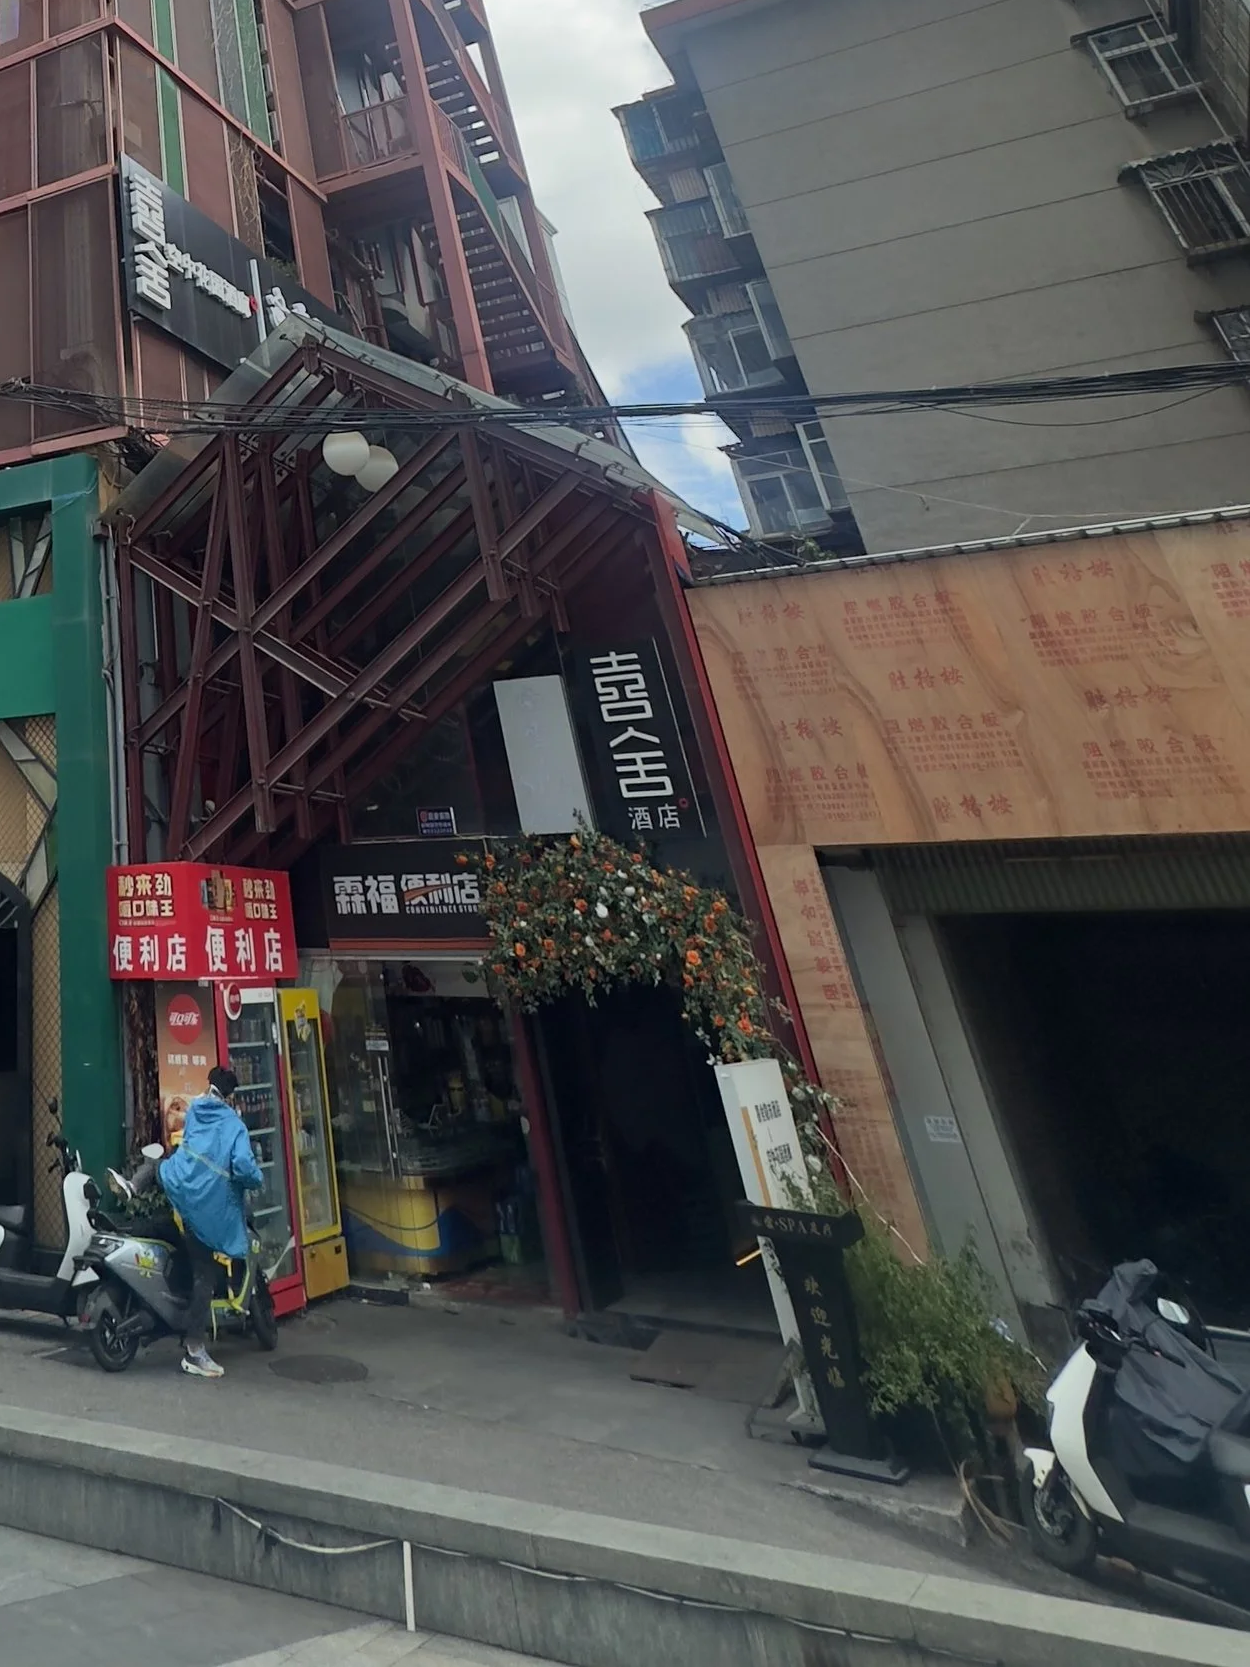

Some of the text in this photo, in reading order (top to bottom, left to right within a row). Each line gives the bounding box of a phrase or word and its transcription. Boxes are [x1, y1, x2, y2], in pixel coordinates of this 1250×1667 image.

[627, 803, 681, 831] 酒店
[458, 904, 479, 914] STOR
[112, 933, 187, 973] 便利店
[205, 925, 283, 973] 便利店
